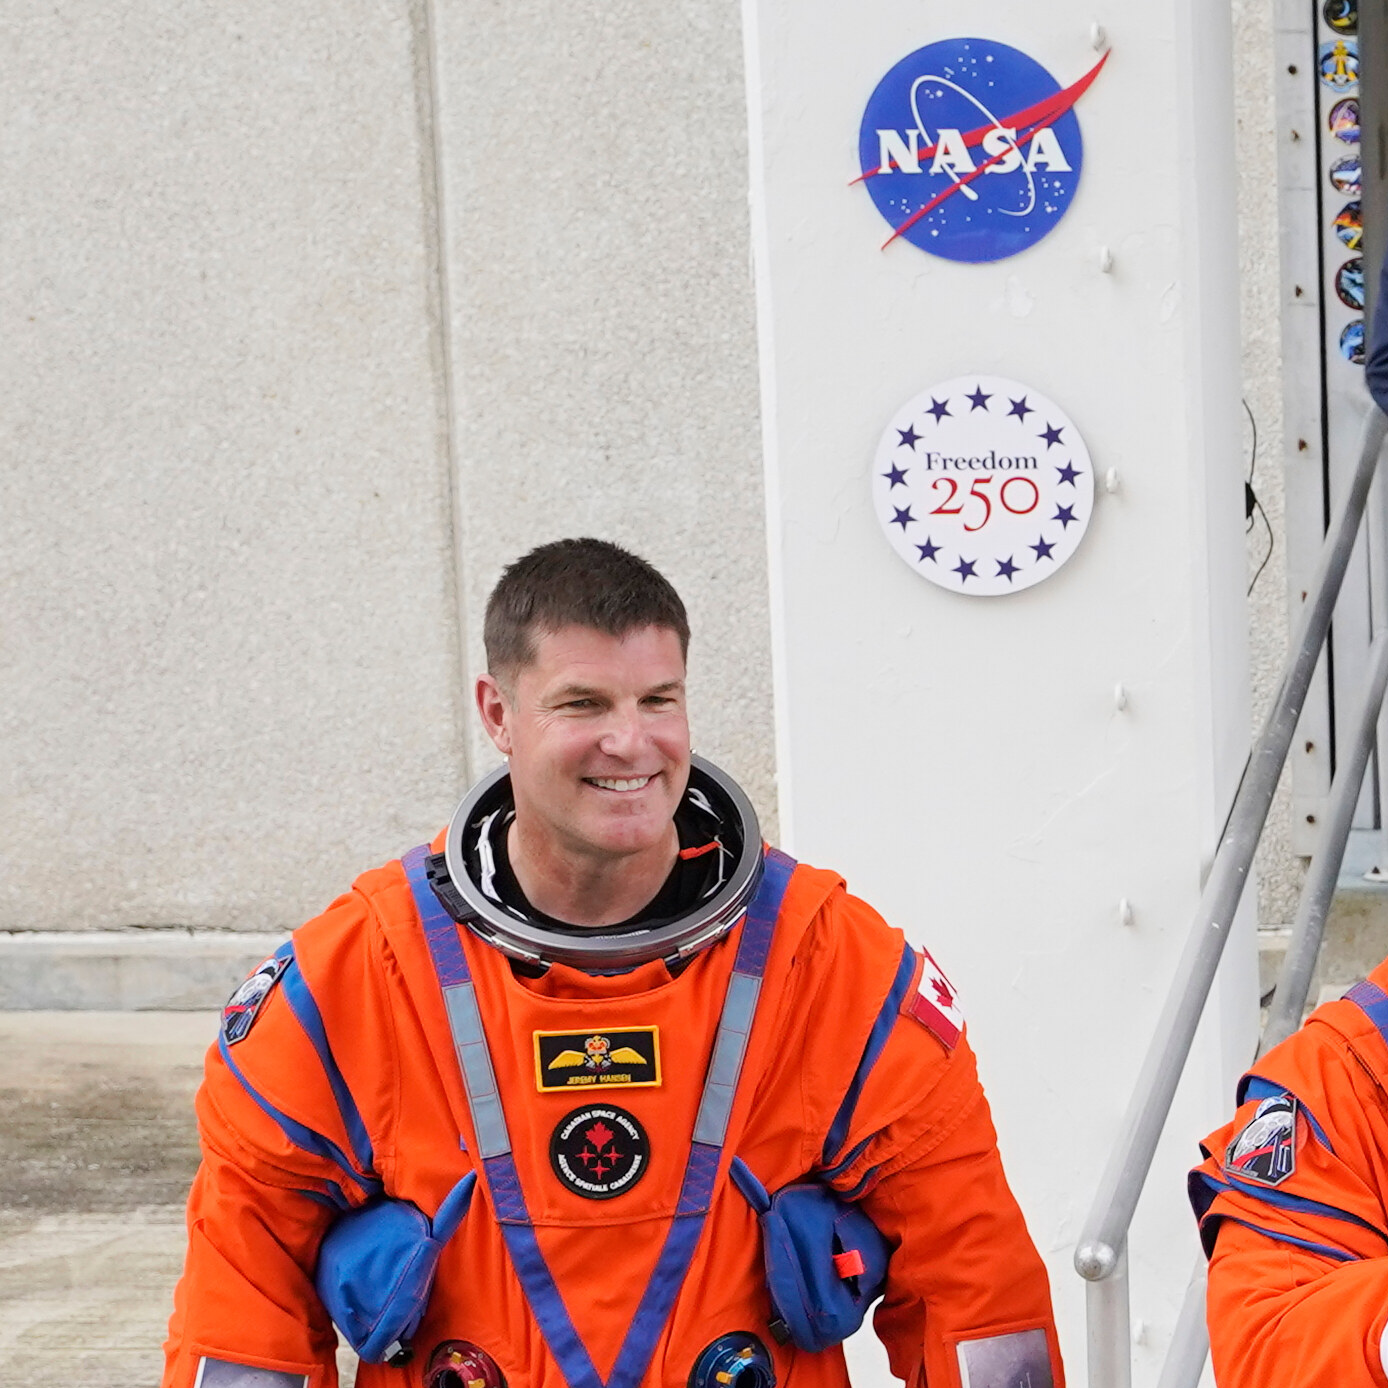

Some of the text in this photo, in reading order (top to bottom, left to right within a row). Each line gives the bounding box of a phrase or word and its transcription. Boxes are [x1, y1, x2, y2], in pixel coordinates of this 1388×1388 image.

[876, 127, 1073, 175] NASA
[925, 450, 1038, 471] Freedom
[929, 474, 1039, 532] 250
